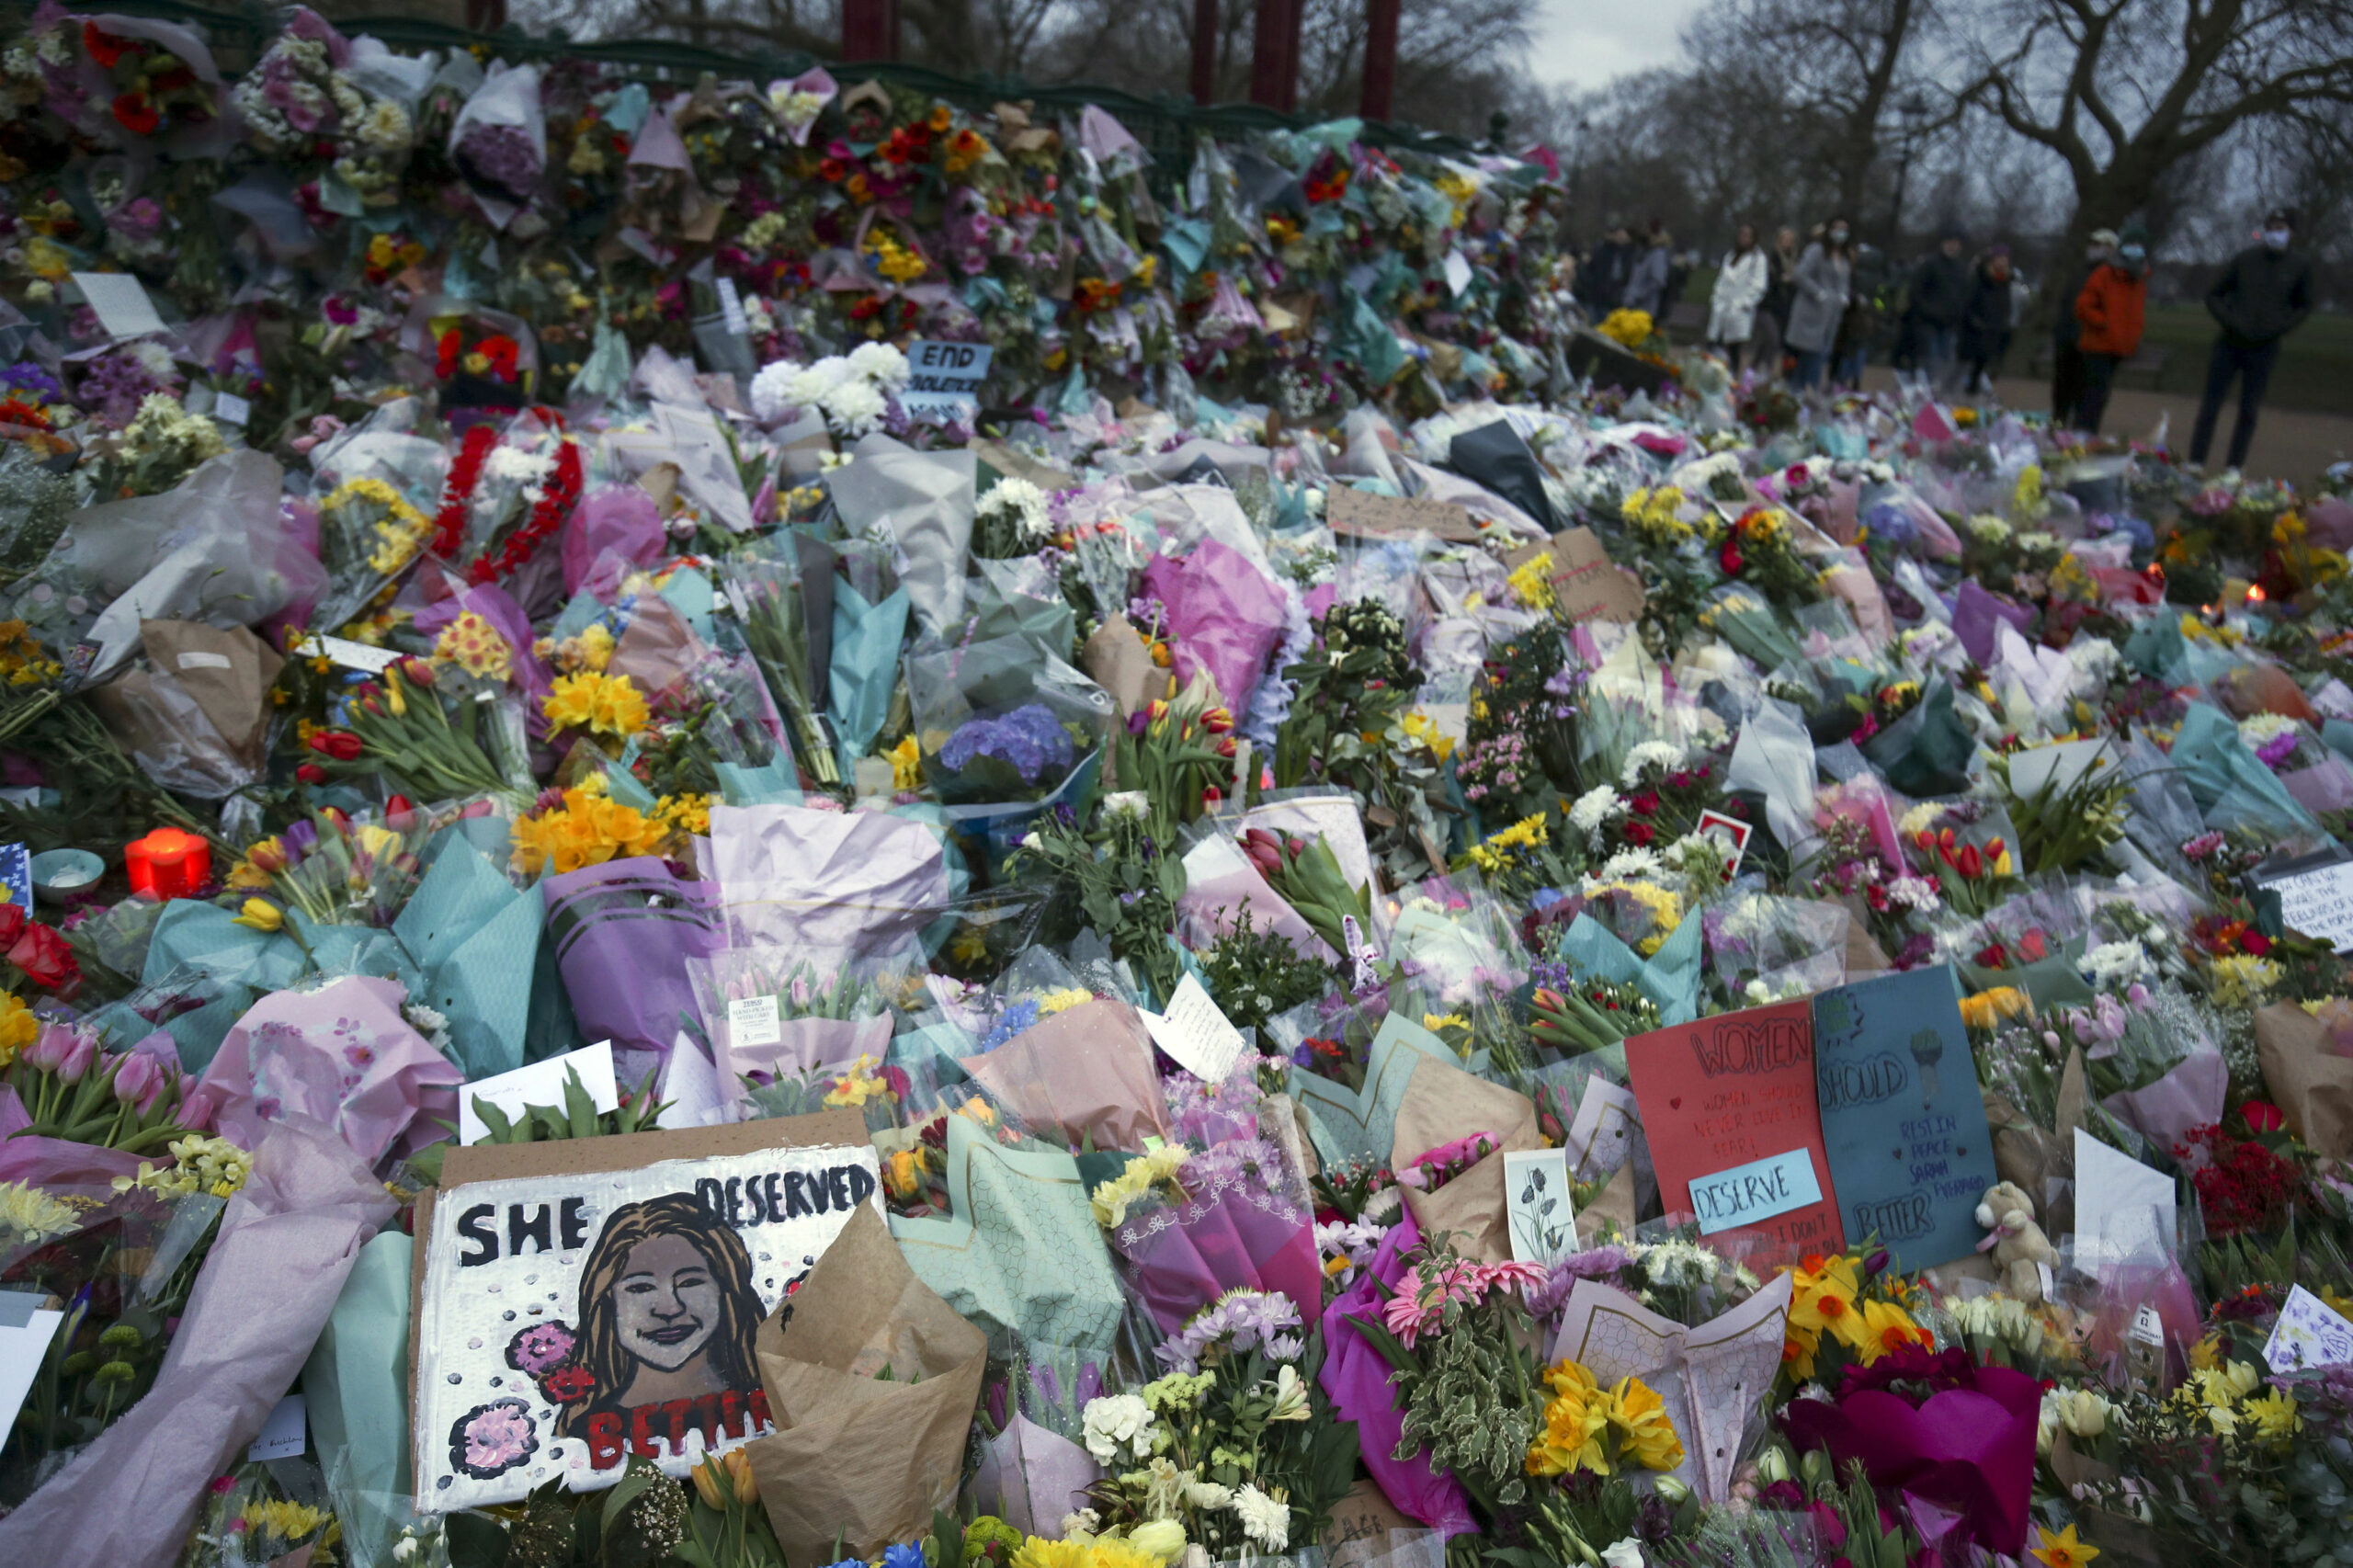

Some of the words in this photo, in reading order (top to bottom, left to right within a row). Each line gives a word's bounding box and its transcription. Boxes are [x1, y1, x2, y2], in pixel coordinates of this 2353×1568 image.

[743, 999, 763, 1007] TESCO
[1690, 1018, 1808, 1078] WOMEN
[1703, 1089, 1751, 1111] WOMEN
[1819, 1053, 1907, 1110] SHOULD
[1693, 1111, 1744, 1138] NEVER
[1900, 1116, 1932, 1140] REST
[1936, 1114, 1957, 1133] IN
[1911, 1139, 1950, 1160] PEACE
[1909, 1158, 1949, 1187] SARAH
[1694, 1165, 1790, 1221] DESERVE
[458, 1197, 589, 1267] SHE
[695, 1164, 876, 1228] DESERVED
[1854, 1190, 1935, 1242] BETTER
[588, 1389, 774, 1471] BETTER
